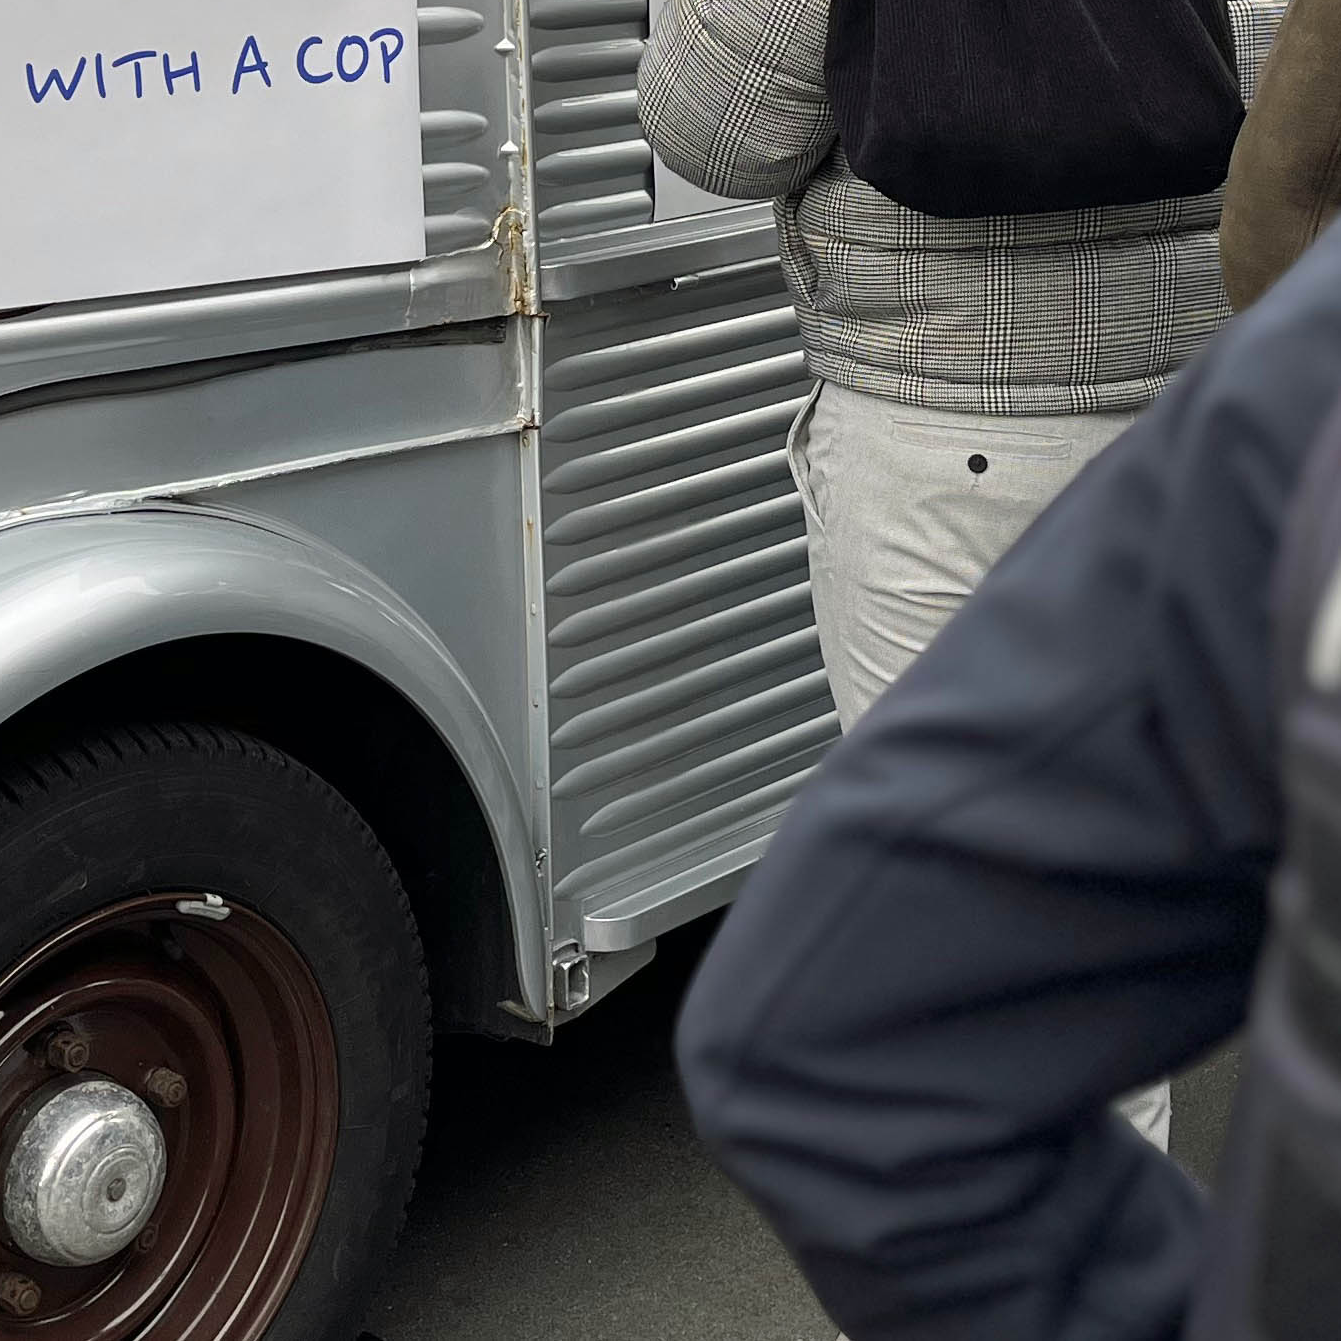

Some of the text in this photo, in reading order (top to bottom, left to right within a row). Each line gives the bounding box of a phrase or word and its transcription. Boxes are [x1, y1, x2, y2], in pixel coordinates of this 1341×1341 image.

[25, 49, 203, 105] WITH
[231, 34, 273, 96] A
[296, 27, 405, 85] COP
